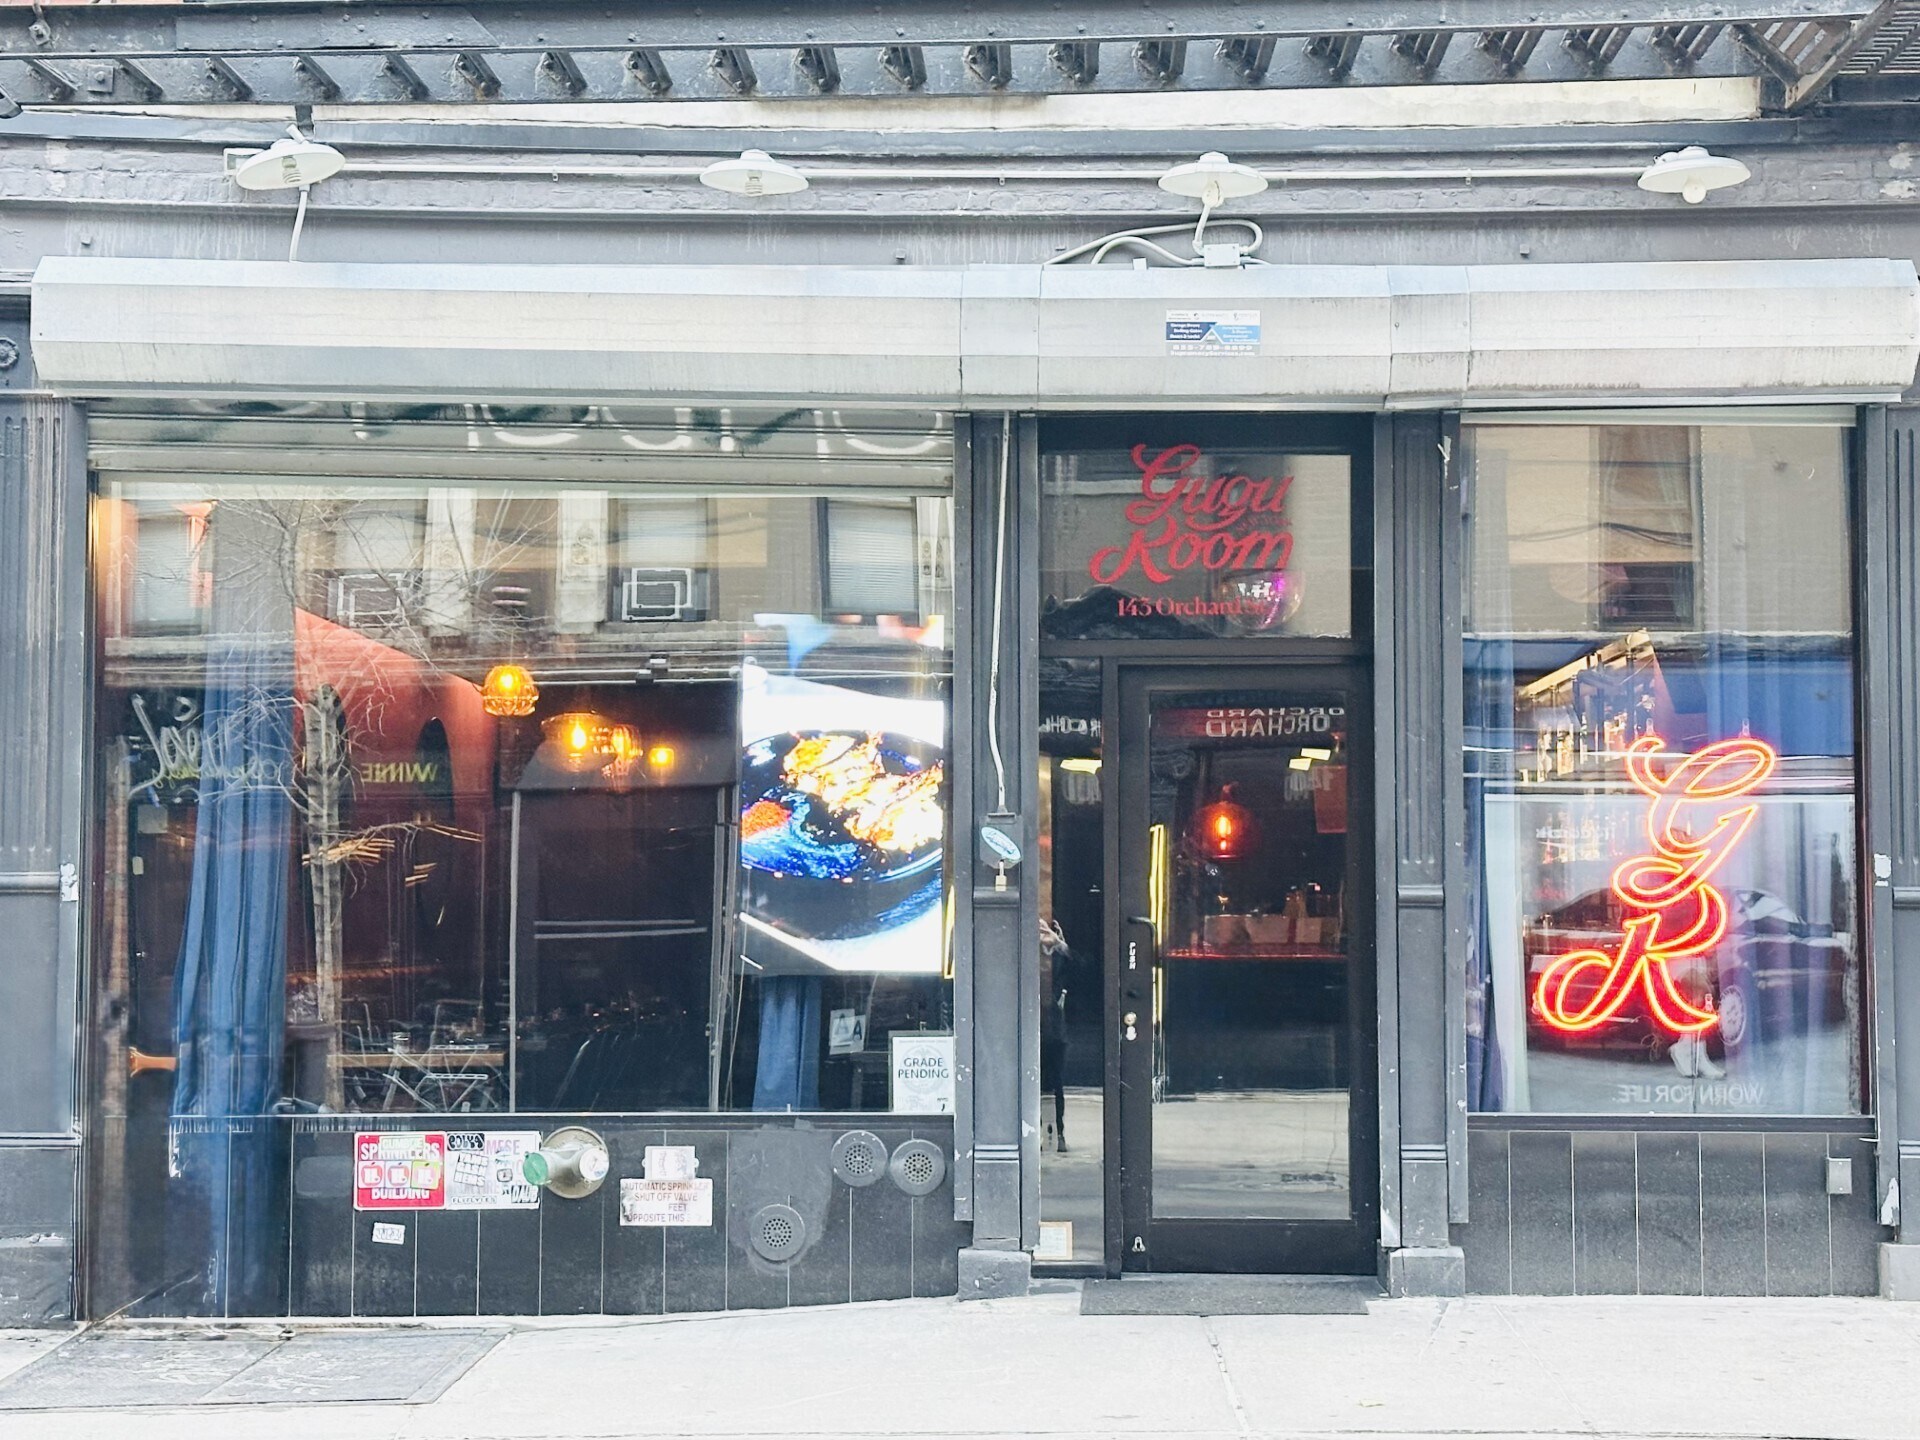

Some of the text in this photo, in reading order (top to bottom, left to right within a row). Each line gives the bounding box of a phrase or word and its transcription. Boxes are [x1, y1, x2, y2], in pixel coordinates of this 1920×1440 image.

[1125, 443, 1294, 531] Gugu
[1089, 514, 1294, 585] Room
[1117, 597, 1152, 617] 143
[1155, 596, 1242, 617] Orchard
[1128, 942, 1137, 970] PUSH
[903, 1057, 944, 1067] GRADE
[897, 1069, 949, 1079] PENDING
[624, 1181, 667, 1191] AUTOMATIC
[634, 1192, 698, 1202] SHUT OFF VALVE
[668, 1203, 687, 1212] FEET
[668, 1212, 685, 1222] THIS
